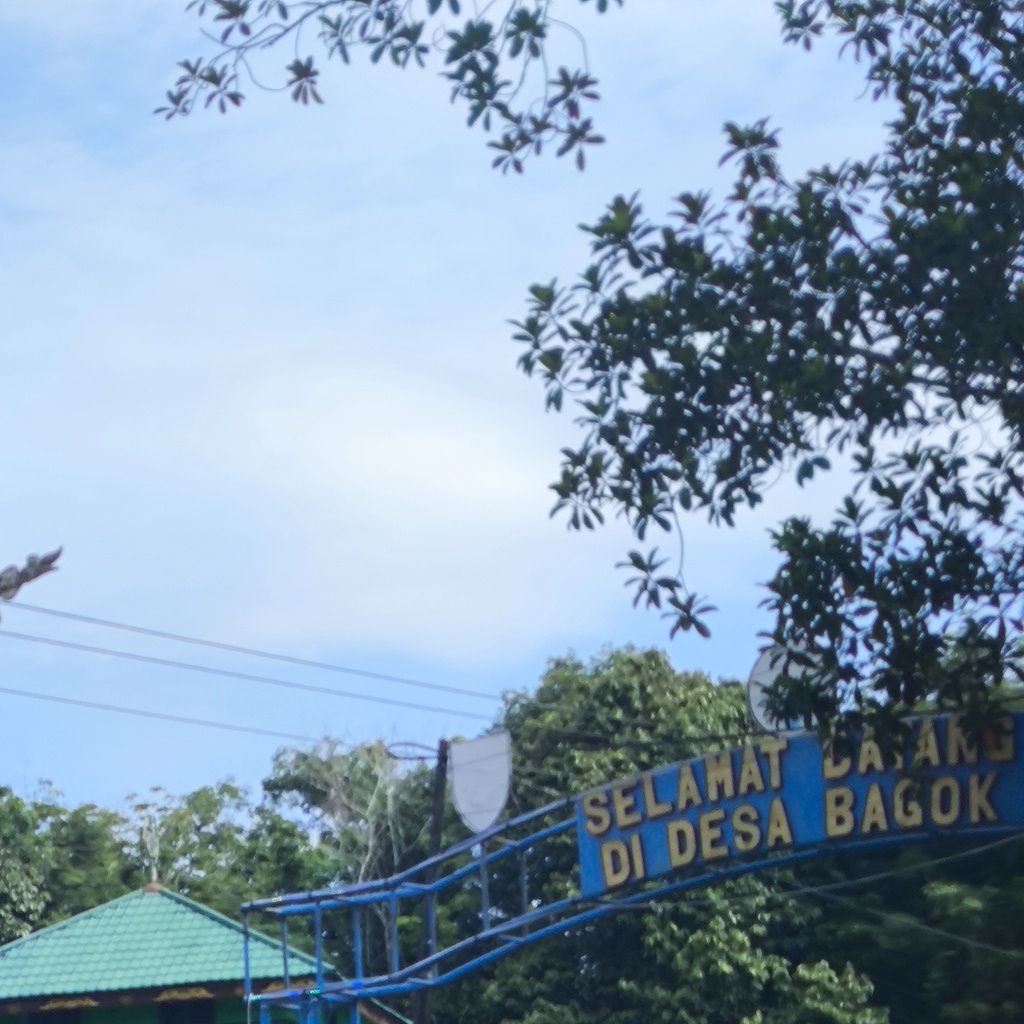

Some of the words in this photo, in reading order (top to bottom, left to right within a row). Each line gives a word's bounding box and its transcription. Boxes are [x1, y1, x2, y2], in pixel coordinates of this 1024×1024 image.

[582, 739, 788, 836] SELAMAT
[599, 833, 646, 889] DI
[665, 797, 794, 869] DESA
[824, 770, 998, 837] BAGOK
